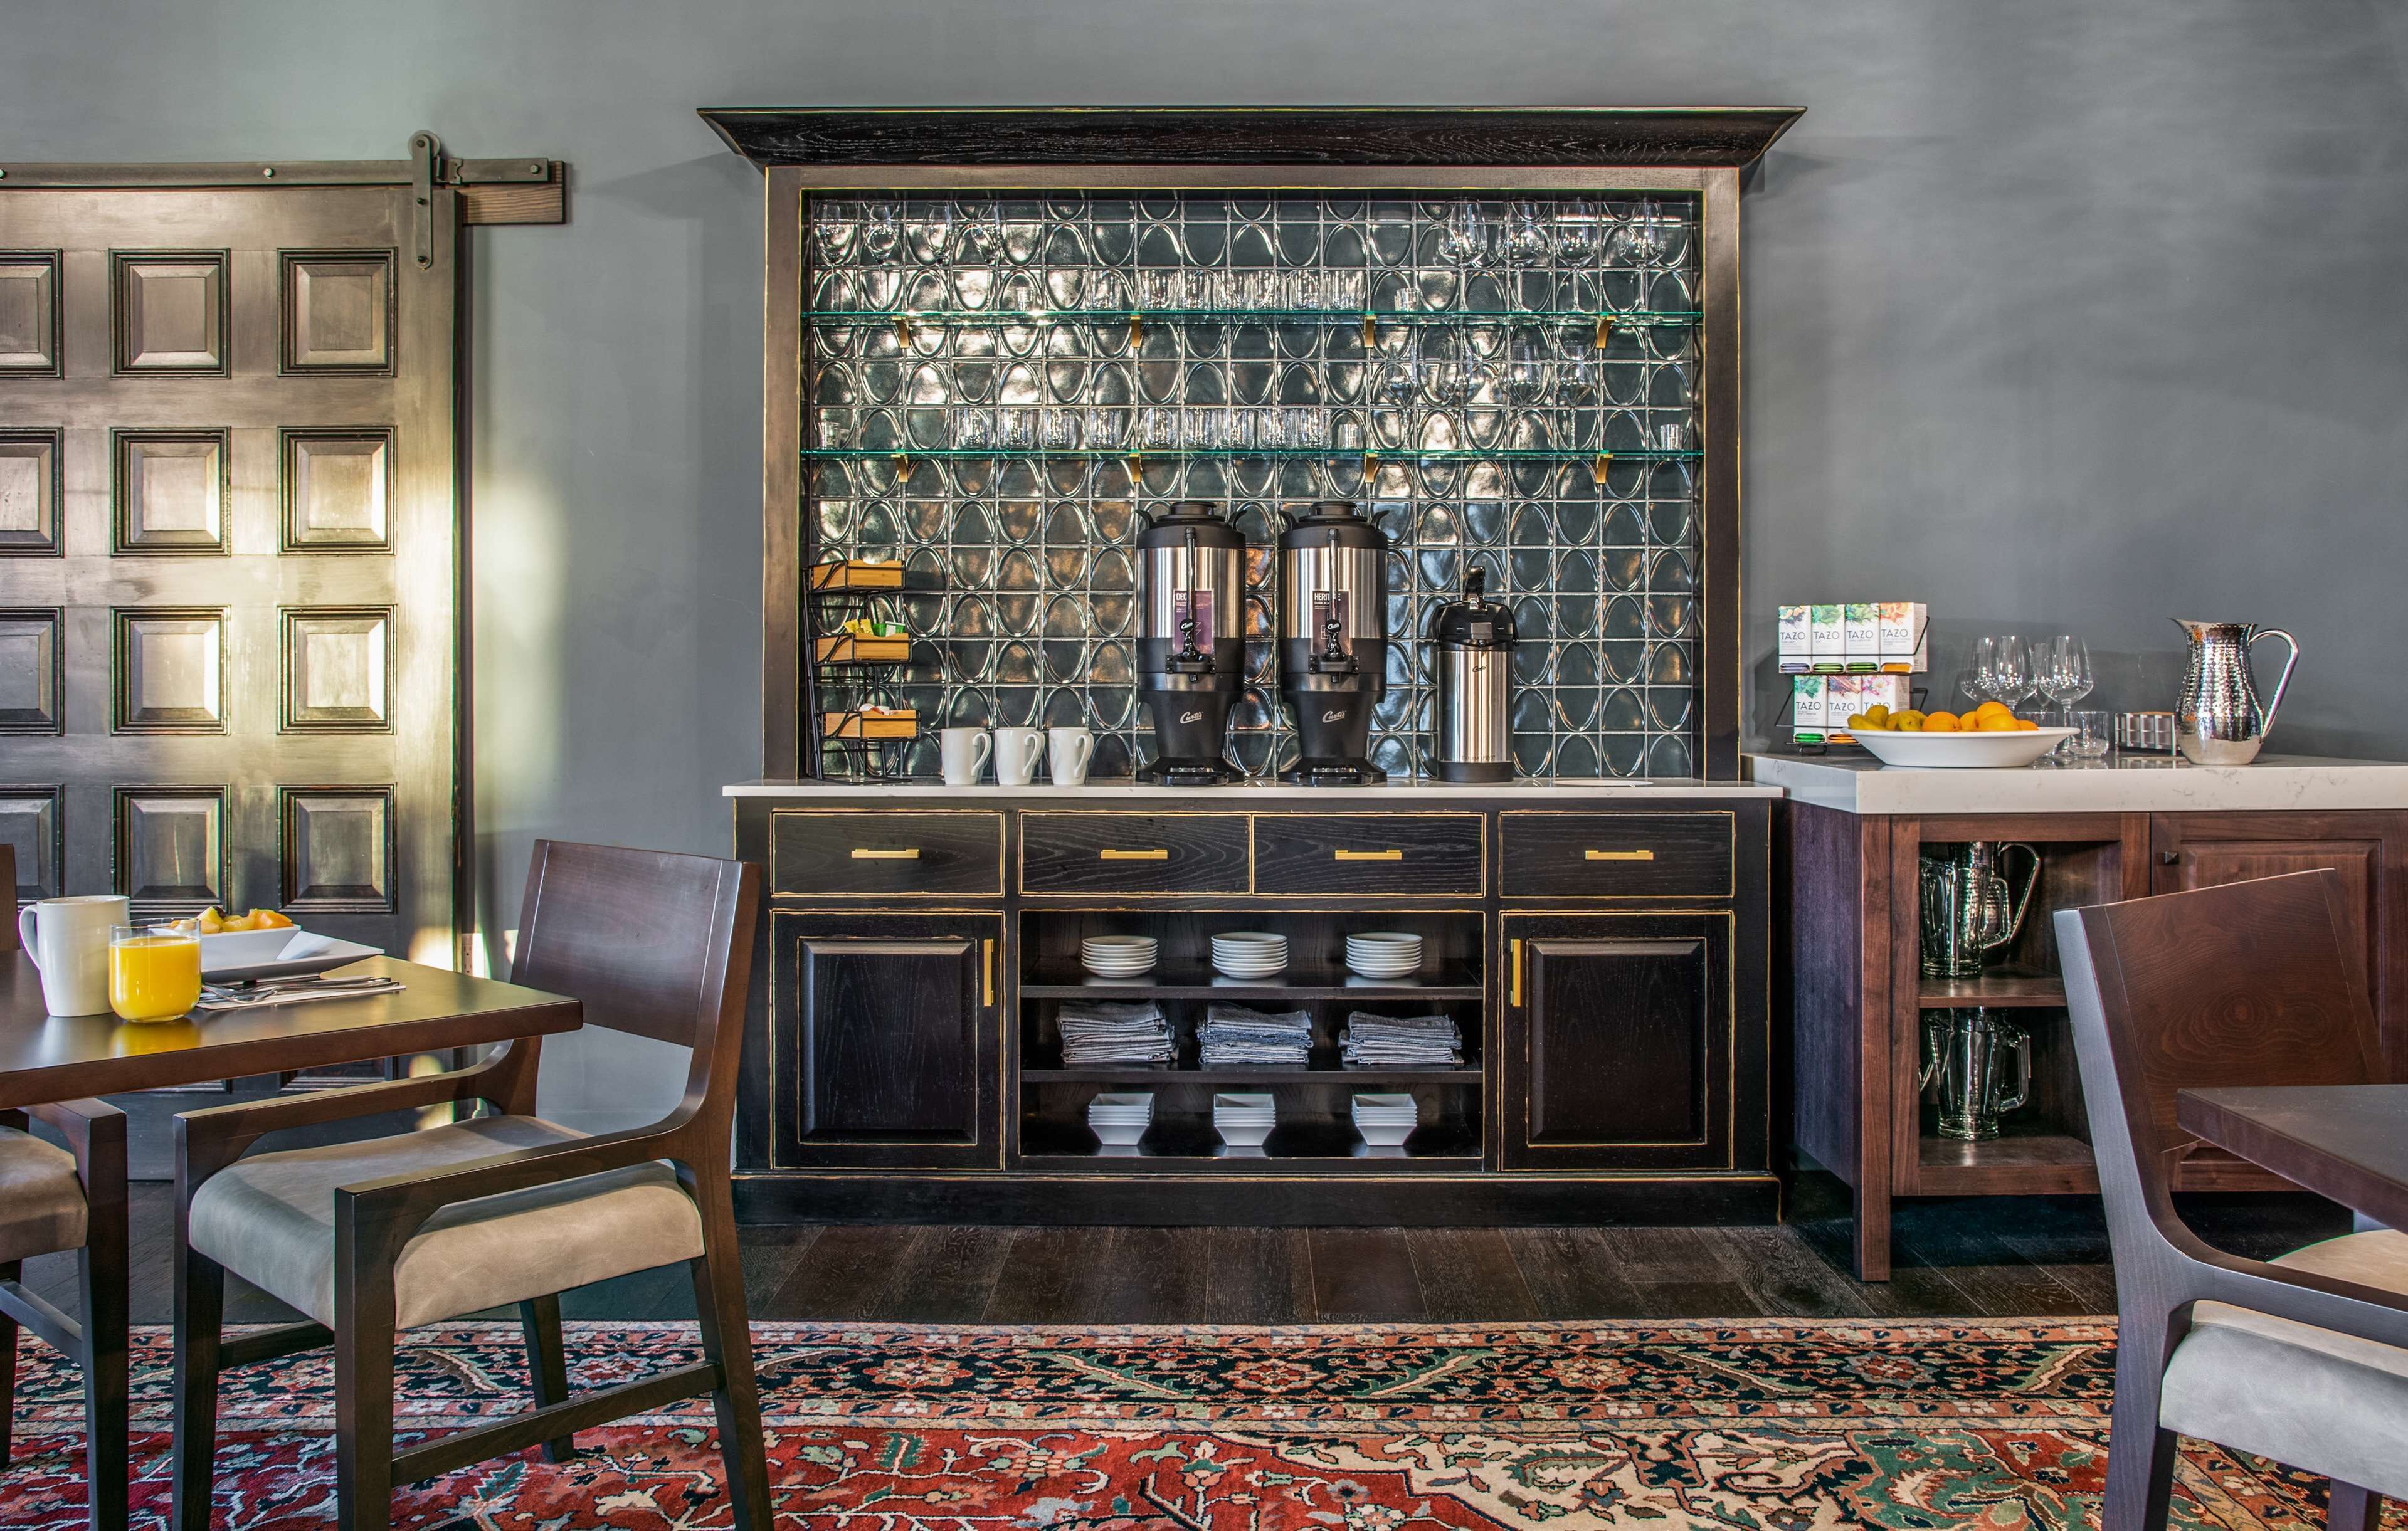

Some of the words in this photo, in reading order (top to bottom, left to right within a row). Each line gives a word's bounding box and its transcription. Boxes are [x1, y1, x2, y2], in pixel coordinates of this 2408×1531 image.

[1780, 631, 1806, 640] TAZO
[1814, 631, 1840, 639] TAZO
[1847, 630, 1874, 639] TAZO
[1881, 629, 1908, 638] TAZO
[1796, 702, 1822, 710] TAZO
[1829, 702, 1856, 712] TAZO
